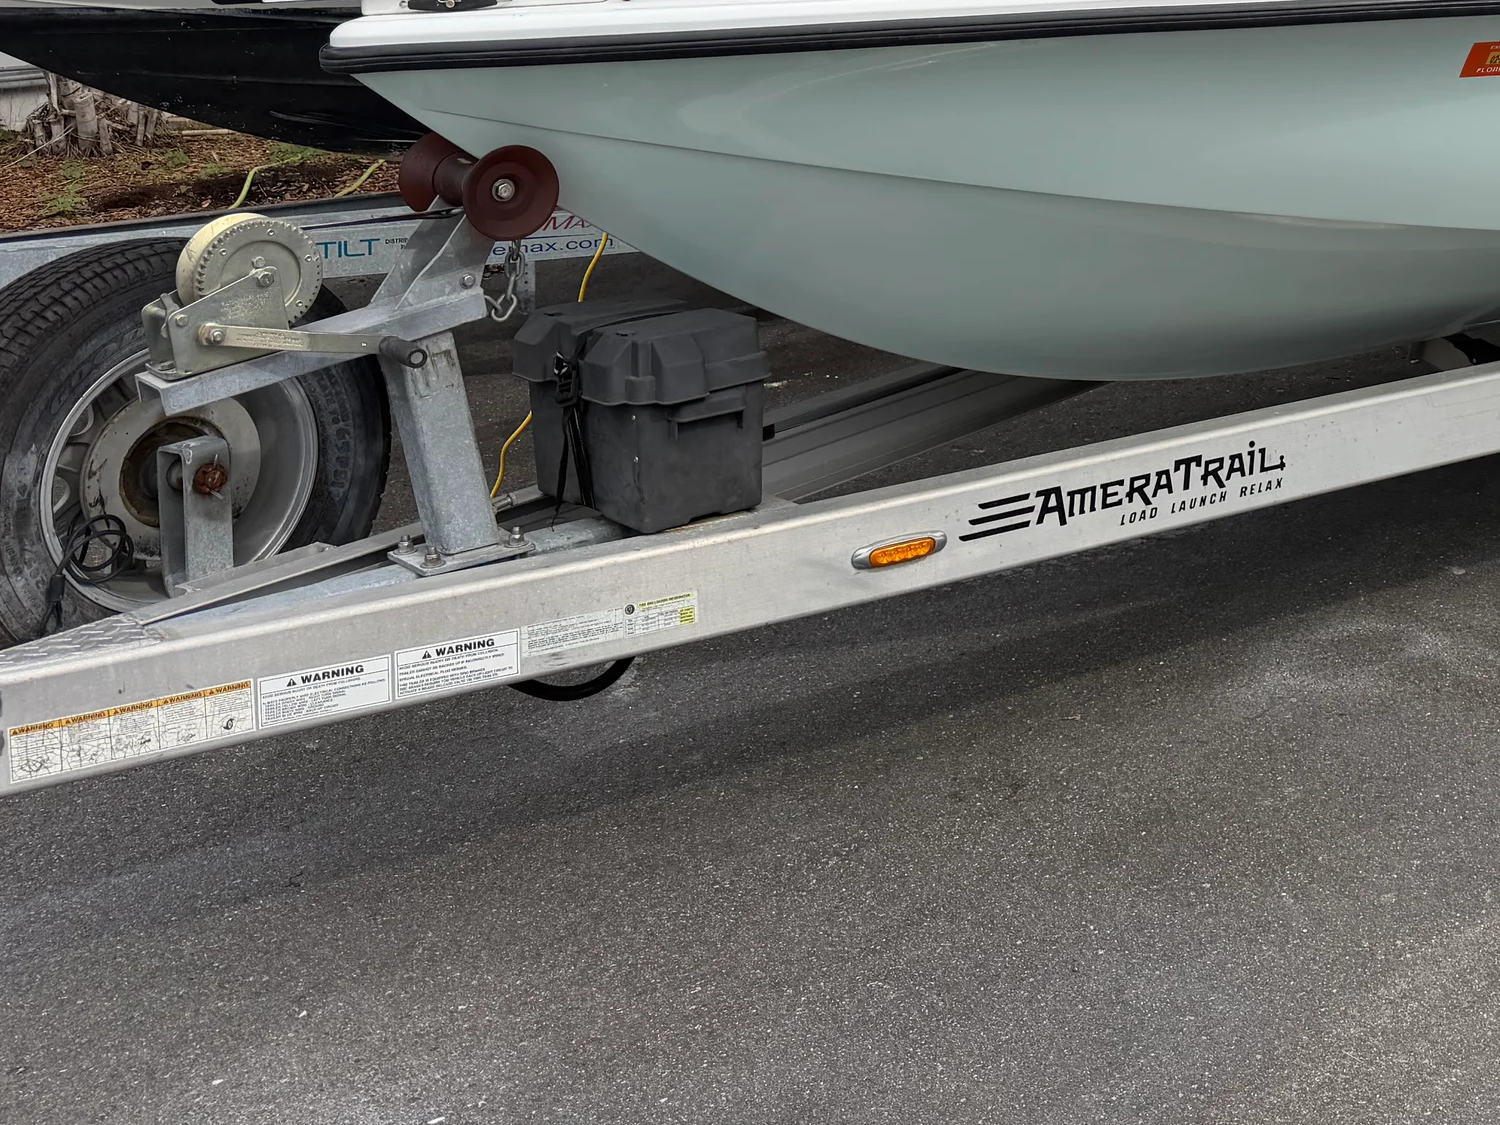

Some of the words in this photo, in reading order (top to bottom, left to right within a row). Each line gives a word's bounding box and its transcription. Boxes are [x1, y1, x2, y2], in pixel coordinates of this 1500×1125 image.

[315, 238, 380, 259] TILT
[1120, 506, 1158, 527] LOAD
[1170, 490, 1228, 515] LAUNCH
[1239, 477, 1284, 499] RELAX
[435, 638, 495, 657] WARNING
[300, 664, 365, 684] WARNING
